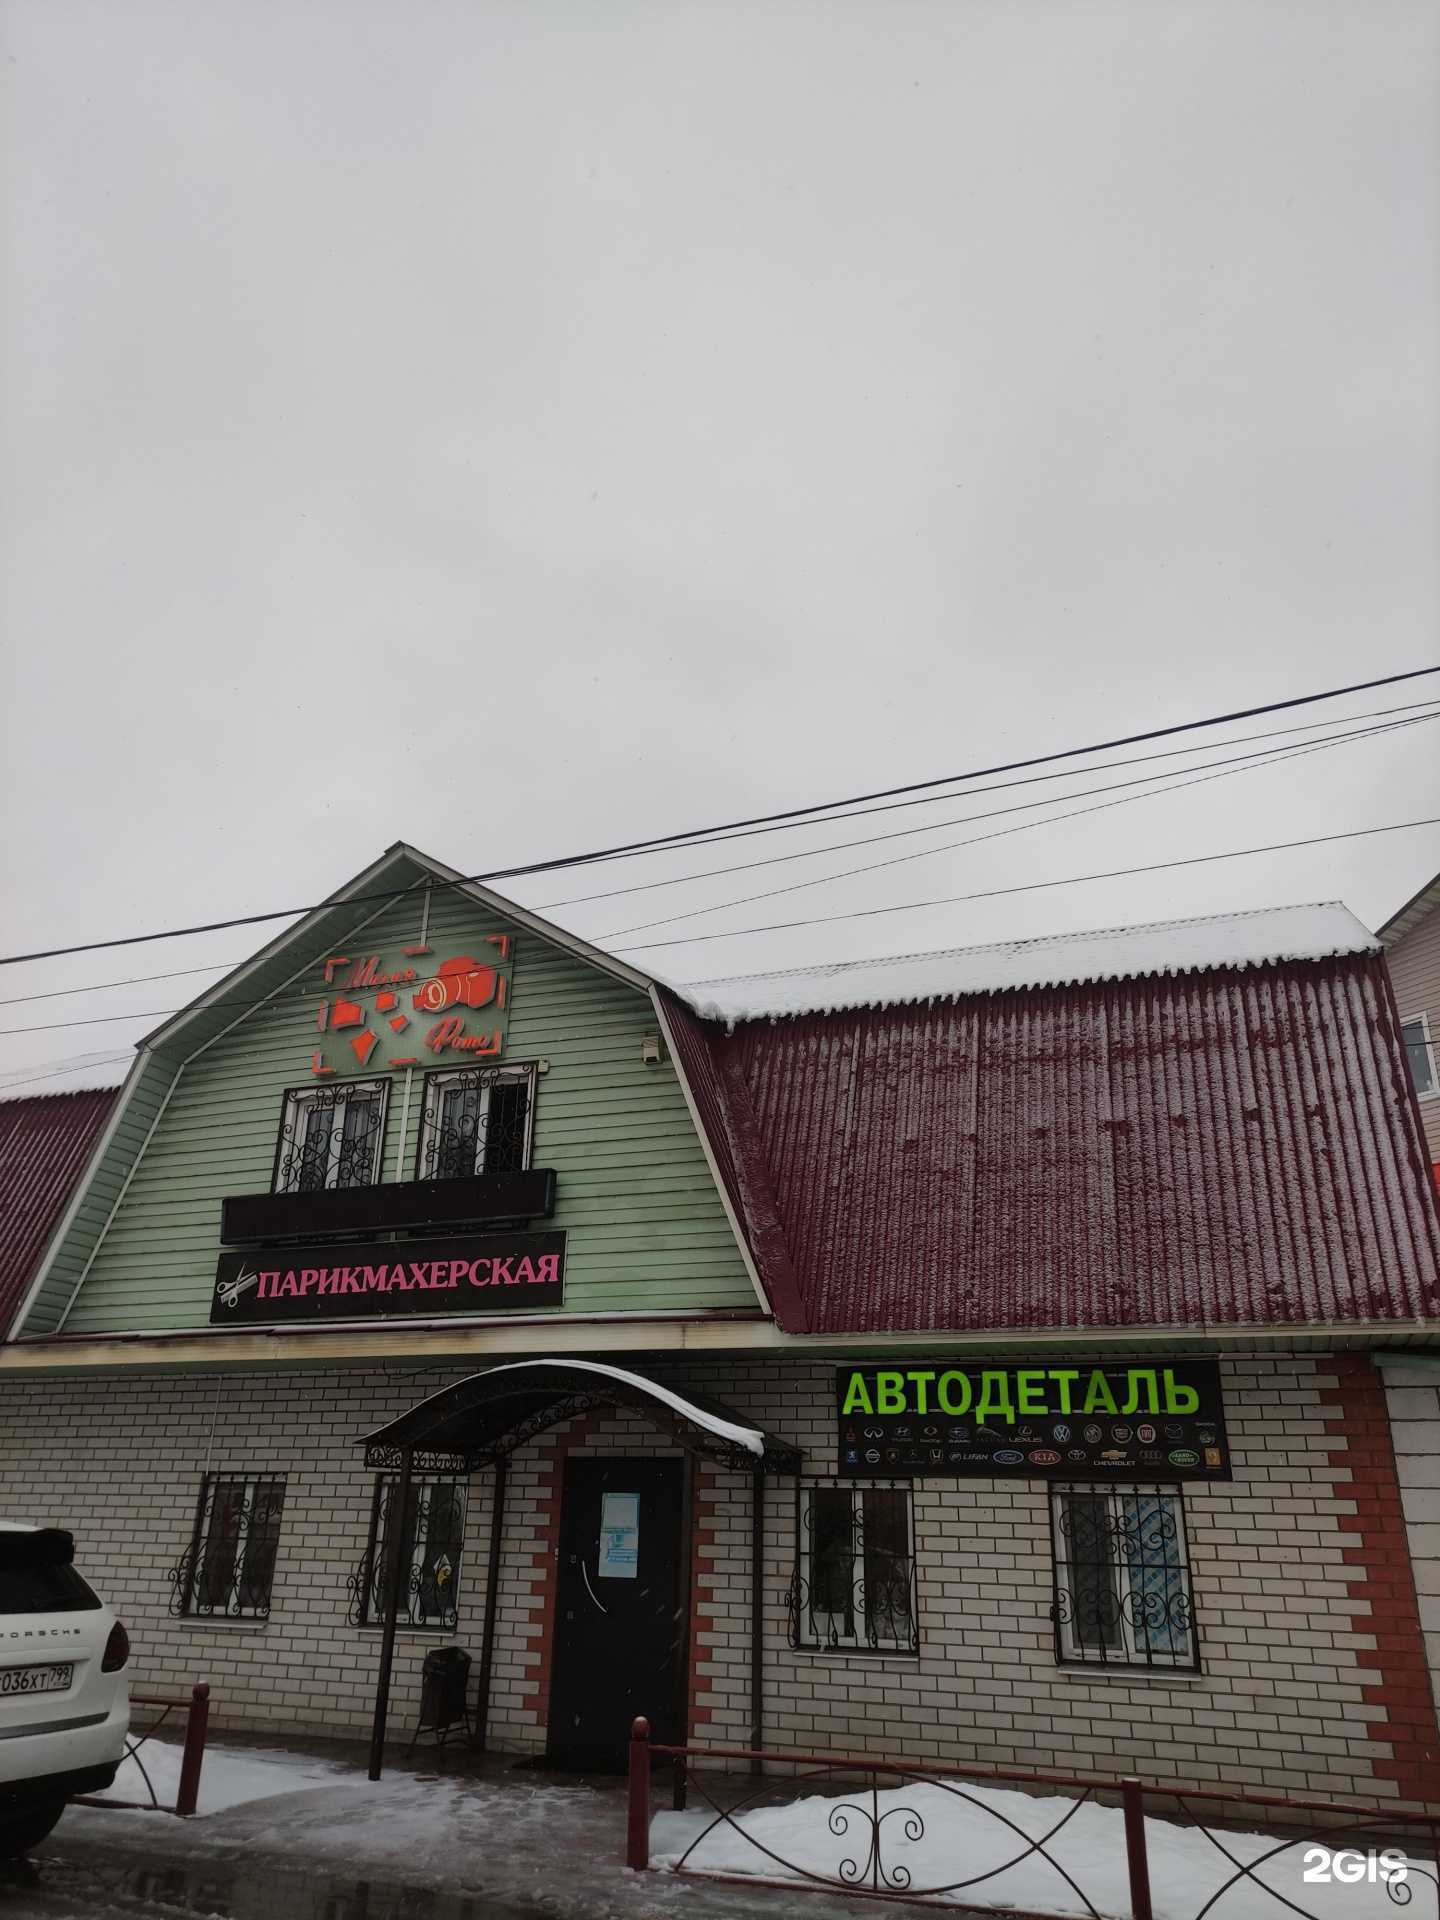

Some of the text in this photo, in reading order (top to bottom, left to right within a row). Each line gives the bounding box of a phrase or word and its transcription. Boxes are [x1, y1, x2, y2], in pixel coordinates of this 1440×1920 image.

[256, 1254, 560, 1298] ПАРИКМАХЕРСКАЯ
[842, 1370, 1200, 1424] АВТОДЕТАЛЬ
[0, 1666, 70, 1691] 036ХТ 799
